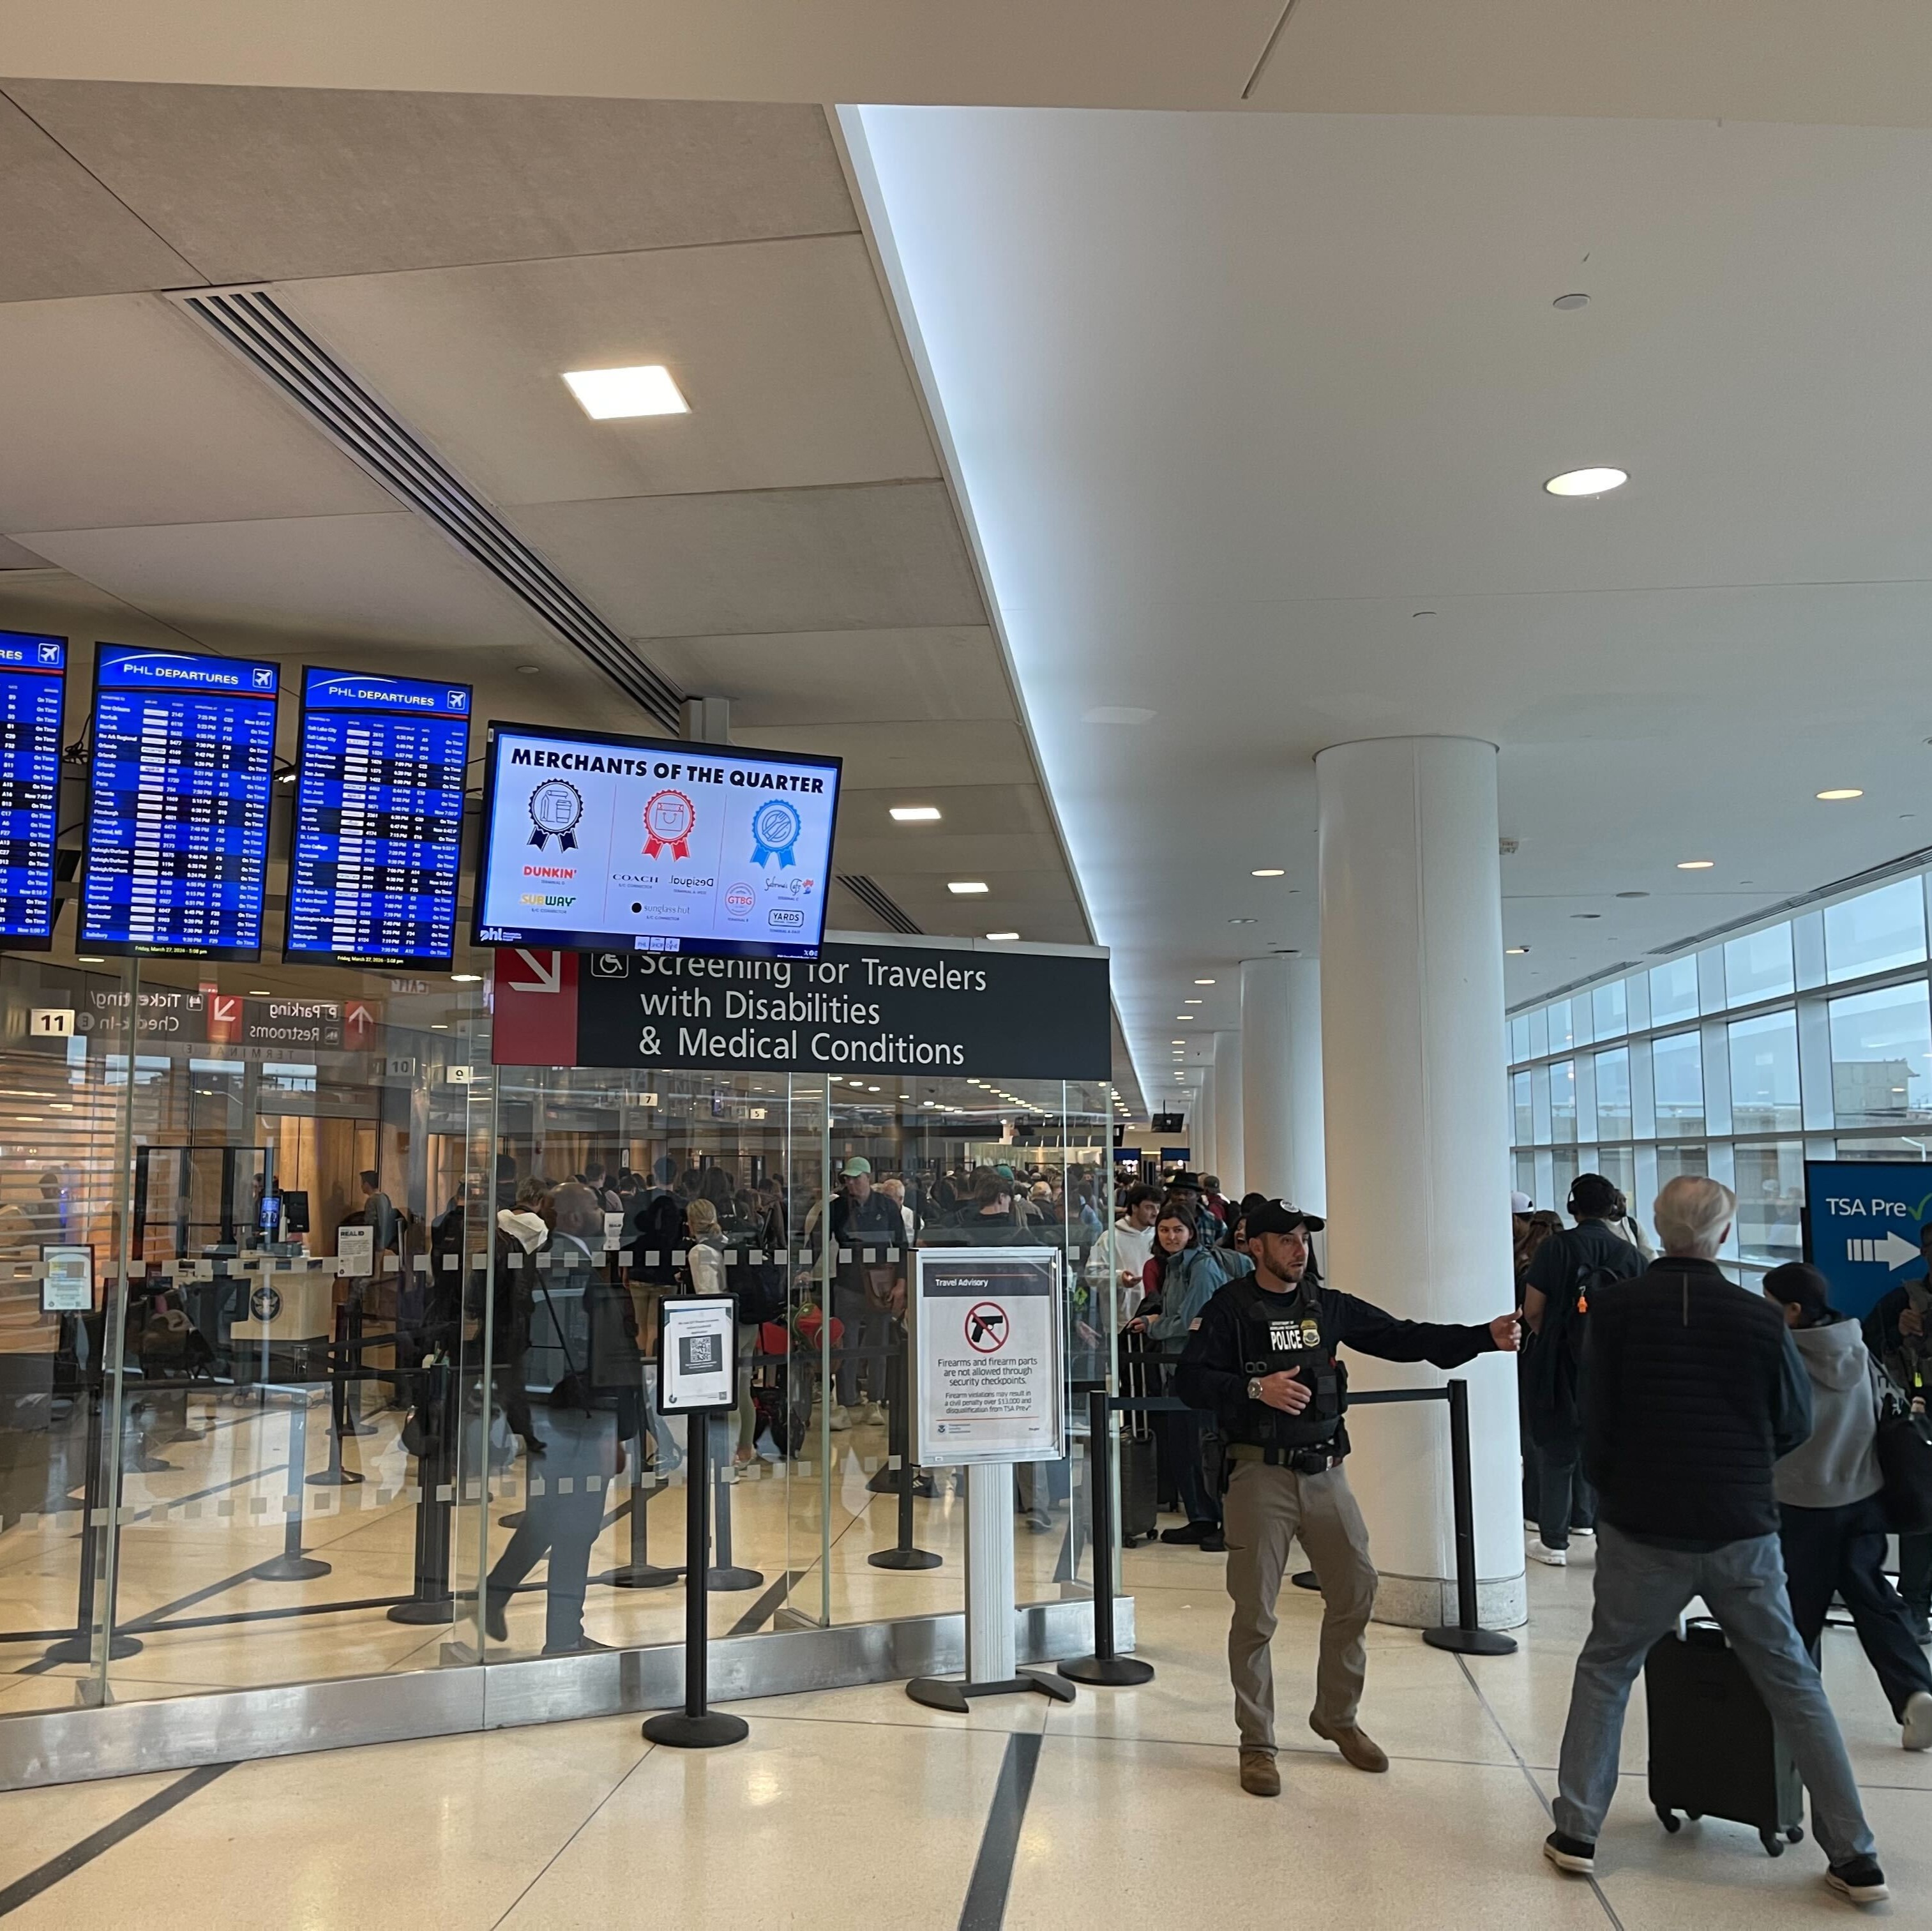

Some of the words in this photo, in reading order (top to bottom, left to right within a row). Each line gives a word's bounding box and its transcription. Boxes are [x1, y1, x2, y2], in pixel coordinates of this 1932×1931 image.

[124, 664, 153, 676] PHL
[155, 667, 239, 685] DEPARTURES
[329, 686, 356, 698] PHL
[358, 690, 434, 706] DEPARTURES
[511, 748, 647, 776] MERCHANTS
[654, 762, 681, 780] OF
[688, 766, 723, 784] THE
[730, 770, 824, 793] QUARTER
[524, 866, 577, 879] DUNKIN'
[613, 874, 658, 882] COACH
[520, 895, 576, 906] SUBWAY
[728, 896, 752, 905] GTBG
[644, 904, 676, 914] sunglass
[480, 927, 502, 941] phl
[640, 955, 790, 988] Screening
[807, 962, 849, 983] for
[862, 958, 986, 991] Travelers
[640, 987, 711, 1017] with
[726, 990, 880, 1025] Disabilities
[42, 1015, 63, 1031] 11
[639, 1026, 661, 1055] &
[679, 1027, 797, 1059] Medical
[811, 1033, 964, 1065] Conditions
[392, 1061, 409, 1073] 10
[1826, 1198, 1866, 1216] TSA
[1872, 1199, 1906, 1216] Pre
[935, 1278, 957, 1287] Travel
[958, 1278, 988, 1287] Advisory
[1271, 1330, 1302, 1351] POLICE
[1018, 1358, 1038, 1366] parts
[1003, 1367, 1032, 1375] through
[949, 1377, 979, 1386] security
